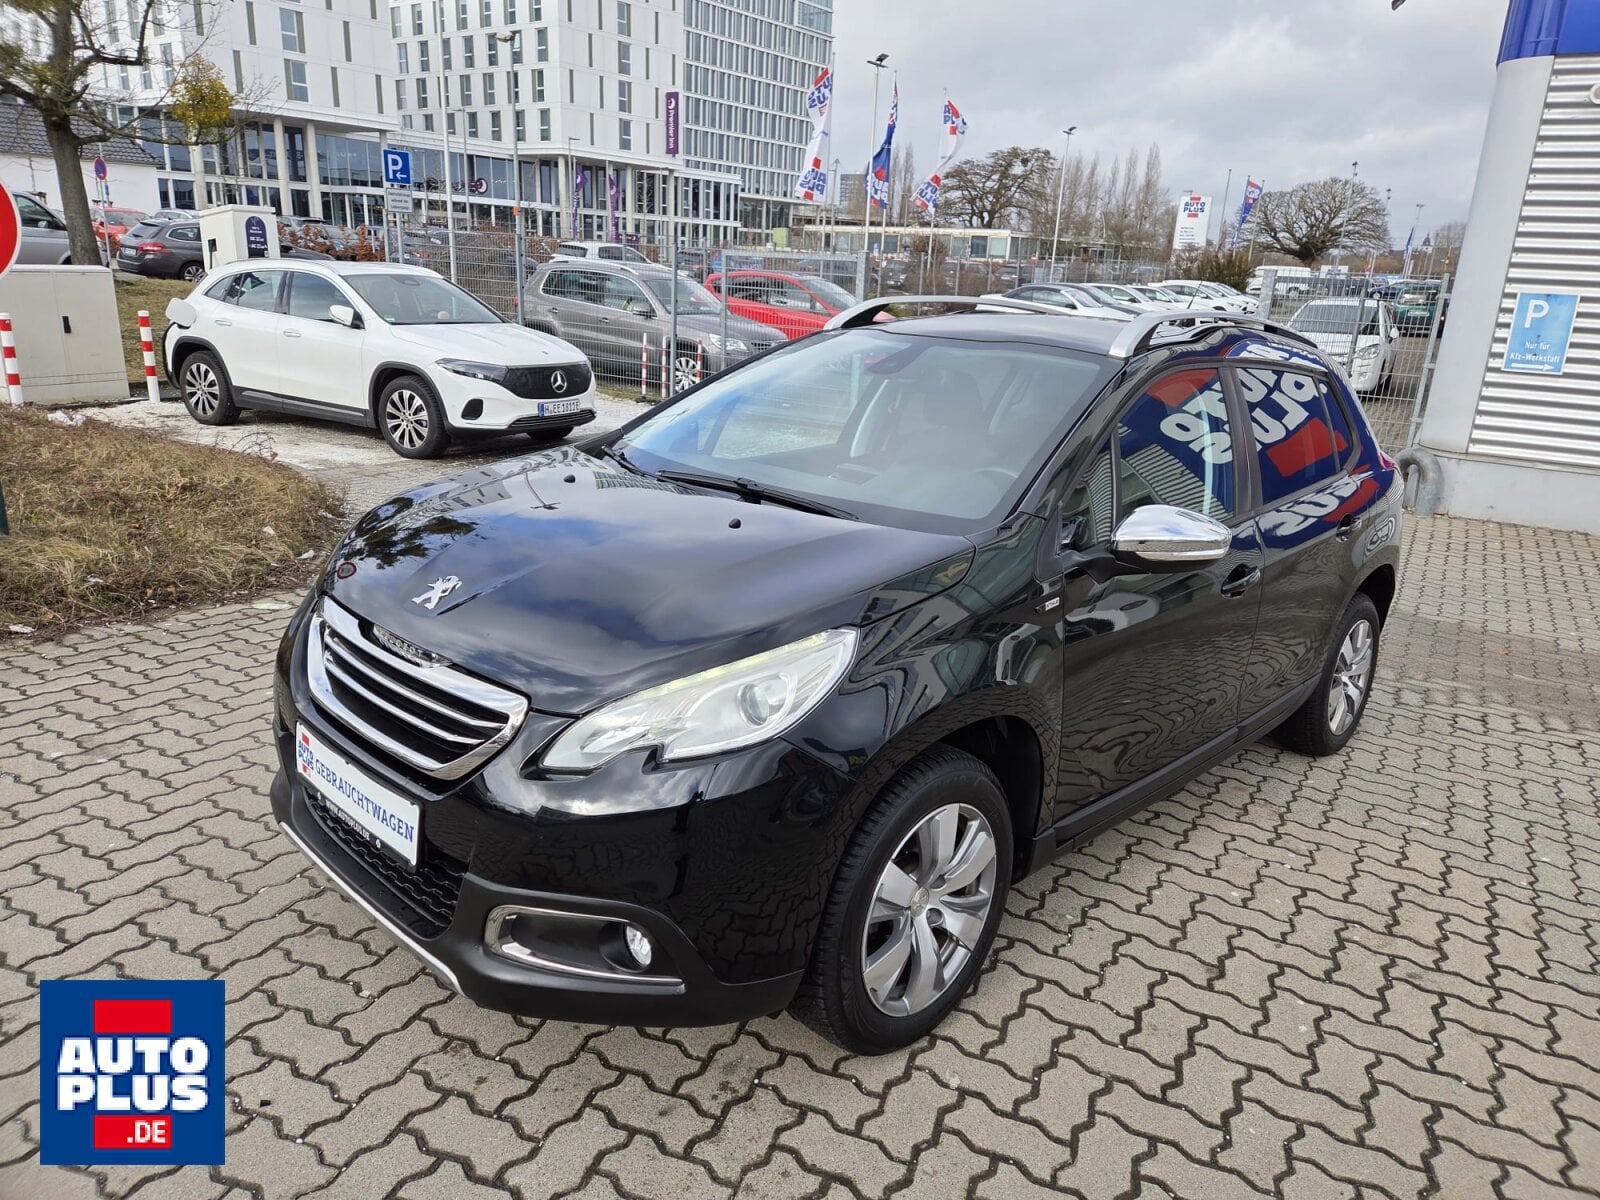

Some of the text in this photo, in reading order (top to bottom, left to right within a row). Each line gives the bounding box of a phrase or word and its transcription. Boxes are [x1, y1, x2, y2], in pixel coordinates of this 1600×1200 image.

[387, 153, 403, 179] P
[1524, 299, 1549, 328] P
[1509, 352, 1561, 363] Kfz-Werkstatt
[1525, 341, 1551, 350] Nur für
[315, 758, 415, 843] GEBRAUCHTWAGEN
